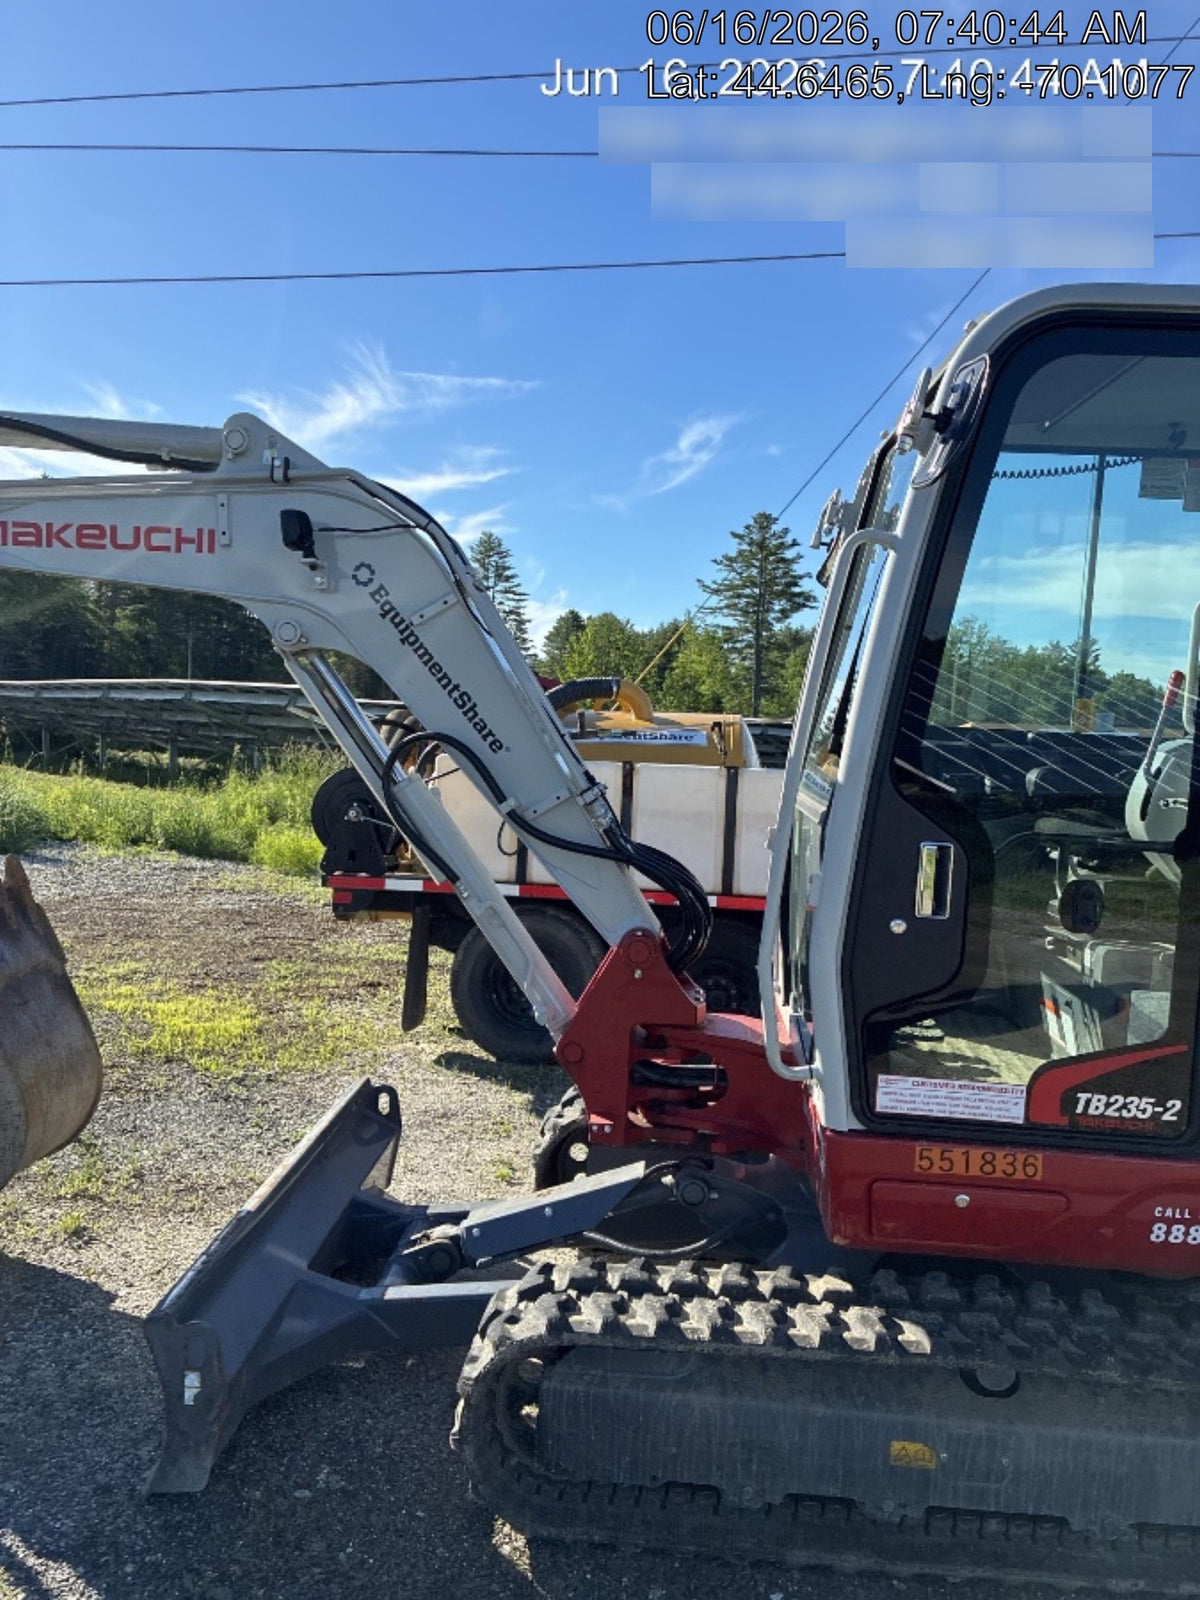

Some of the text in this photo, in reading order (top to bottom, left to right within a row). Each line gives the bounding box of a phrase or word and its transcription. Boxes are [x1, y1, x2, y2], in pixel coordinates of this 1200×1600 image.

[369, 582, 504, 755] EquipmentShare
[1075, 1093, 1182, 1121] TB235-2
[917, 1147, 1039, 1178] 551836
[1154, 1206, 1192, 1219] CALL
[1150, 1222, 1200, 1245] 888
